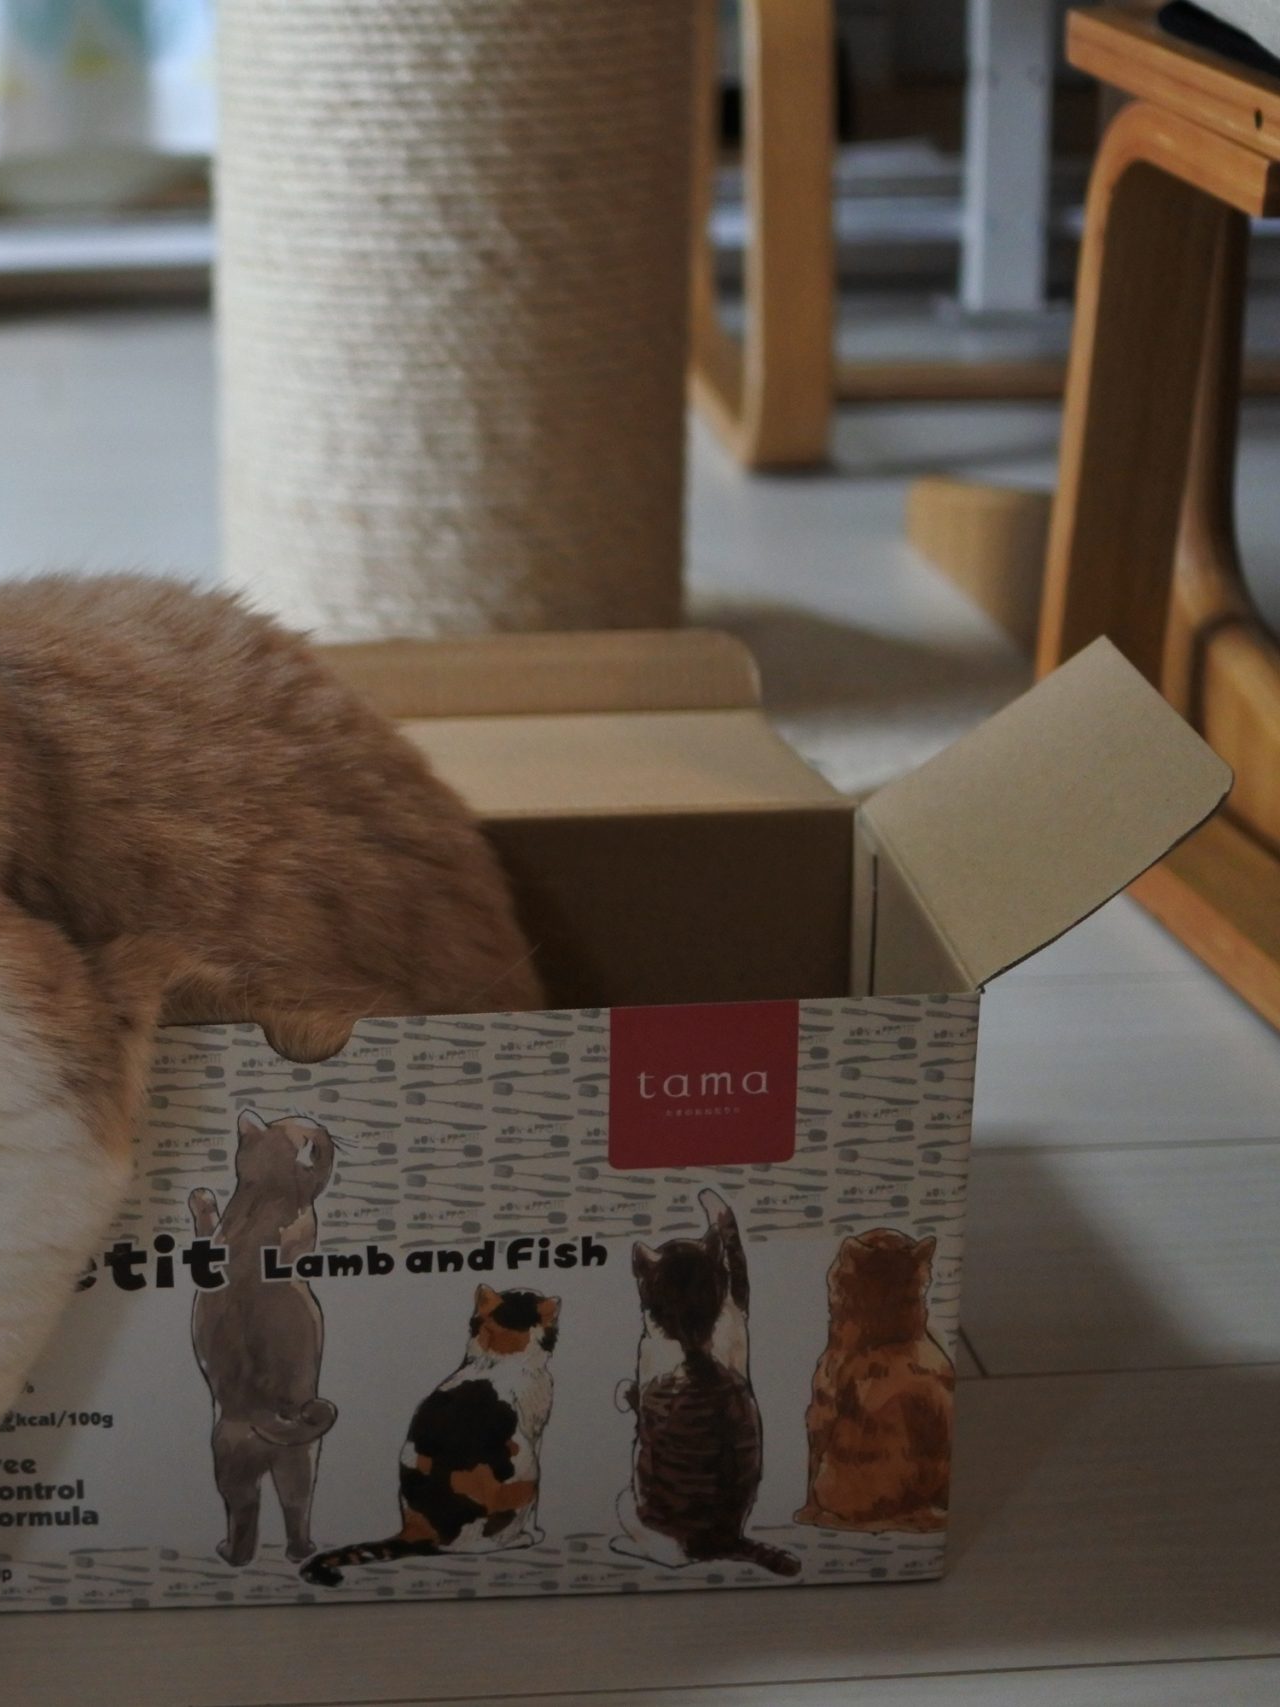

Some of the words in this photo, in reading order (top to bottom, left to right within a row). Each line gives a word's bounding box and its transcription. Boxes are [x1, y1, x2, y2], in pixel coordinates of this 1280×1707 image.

[637, 1071, 768, 1098] tama
[263, 1245, 395, 1279] Lamb
[405, 1241, 496, 1273] and
[506, 1236, 608, 1270] Fish
